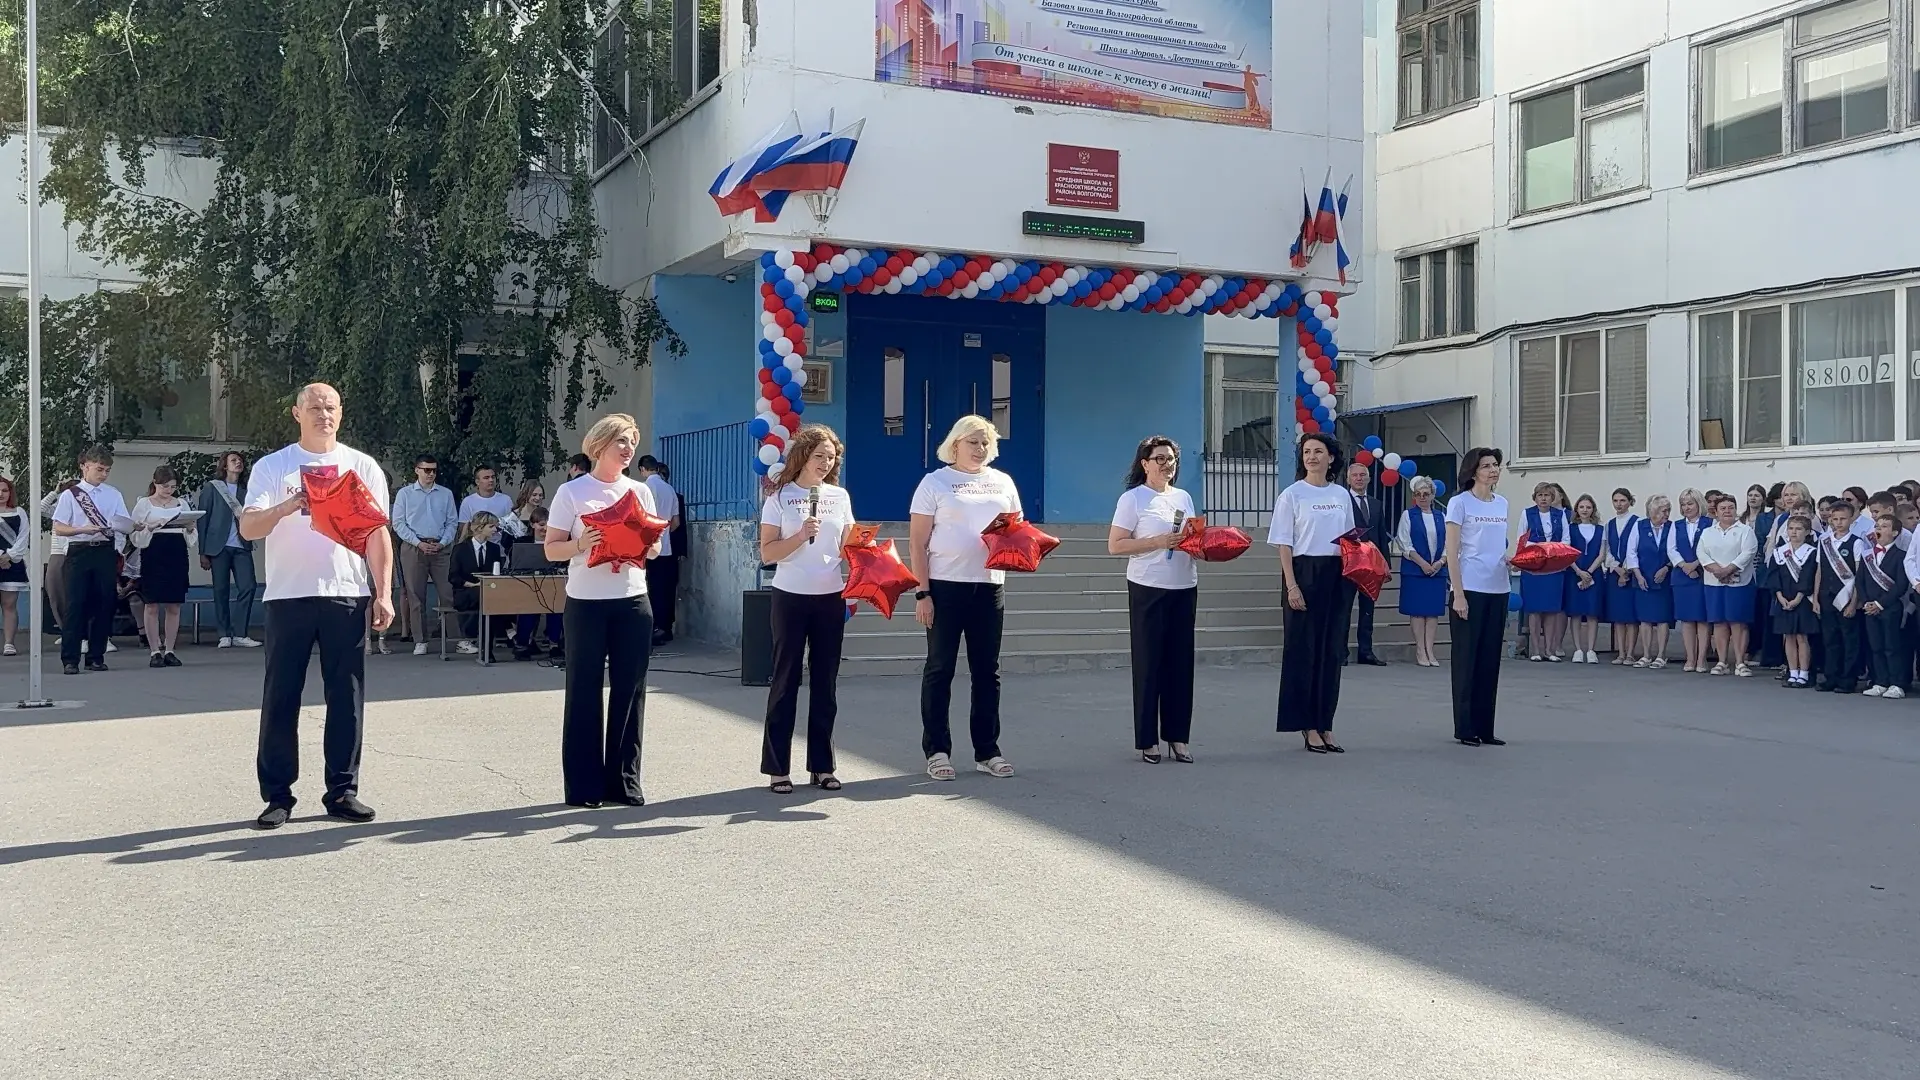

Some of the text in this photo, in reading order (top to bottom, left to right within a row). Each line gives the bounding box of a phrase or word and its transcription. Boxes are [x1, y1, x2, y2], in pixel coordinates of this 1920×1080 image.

[1041, 0, 1198, 29] Базовая школа Волгоградской области
[1066, 20, 1227, 51] Региональная инновационная площадка
[1100, 43, 1128, 54] Школа
[1215, 61, 1240, 69] среда»
[994, 45, 1014, 58] От
[1016, 51, 1055, 67] успеха
[1058, 60, 1065, 69] в
[1067, 63, 1104, 77] школе
[1114, 73, 1122, 81] к
[1123, 75, 1159, 91] успеху
[1161, 82, 1168, 90] в
[1169, 84, 1213, 99] жизни!
[1056, 176, 1083, 184] «СРЕДНЯЯ
[1054, 182, 1114, 193] КРАСНООКТЯБРЬСКОГО
[1055, 188, 1112, 199] РАЙОНА ВОЛГОГРАДА»
[815, 298, 838, 307] ВХОД
[787, 498, 839, 506] ИНЖНЕР-
